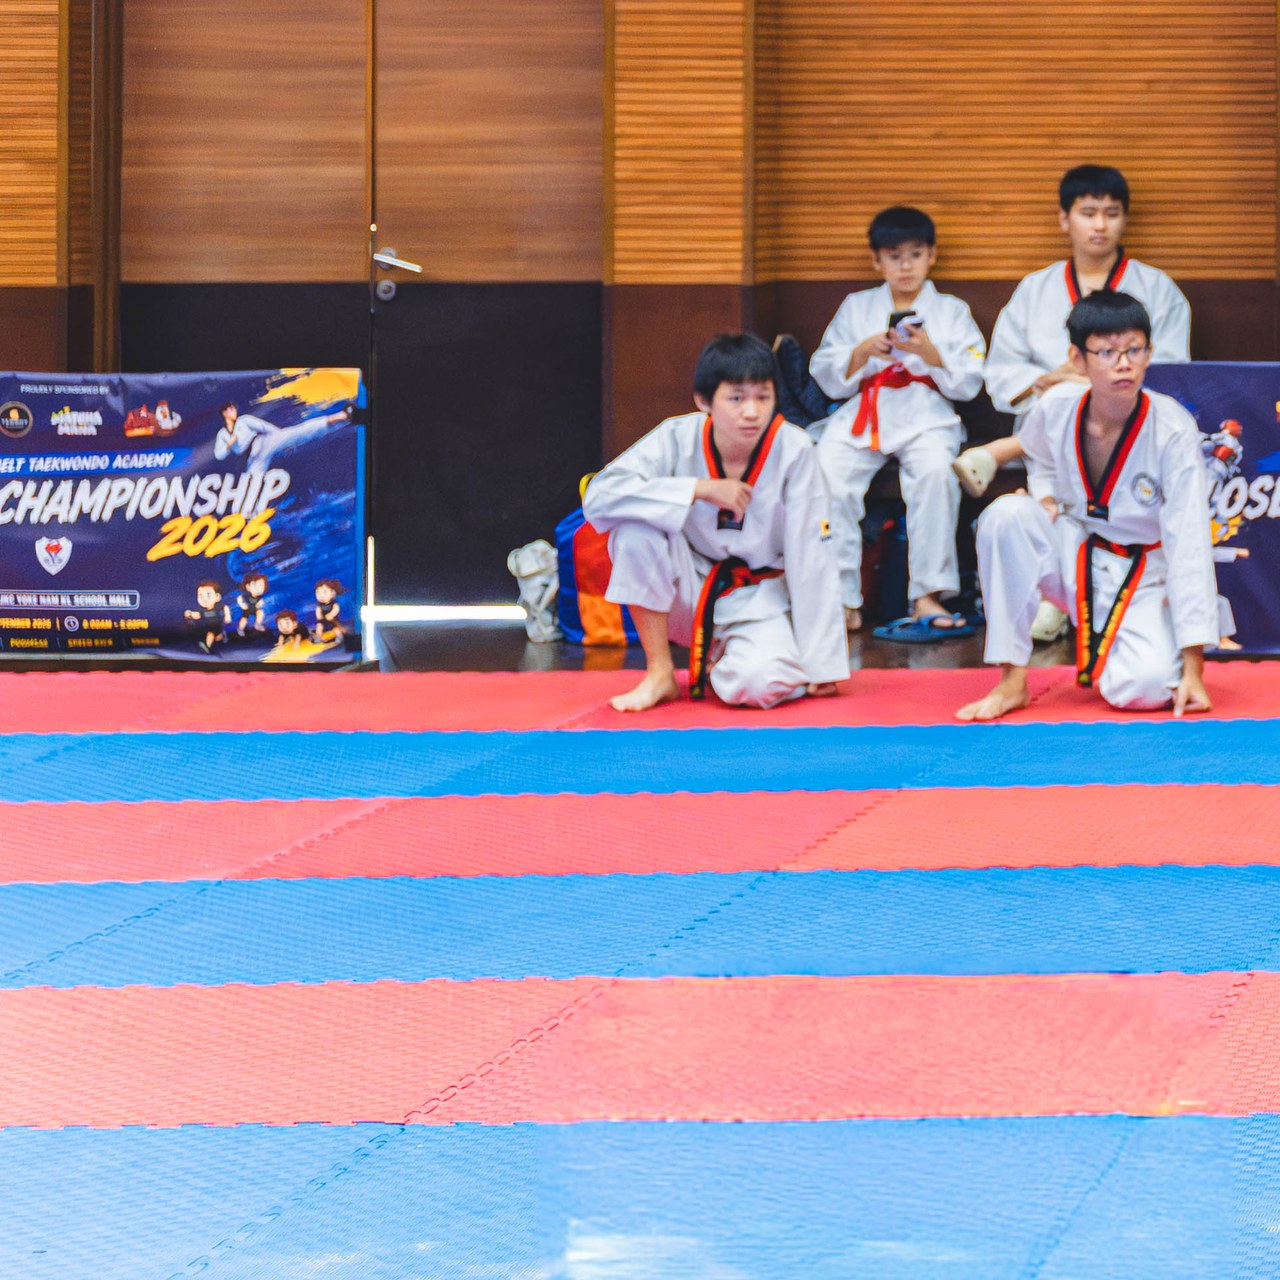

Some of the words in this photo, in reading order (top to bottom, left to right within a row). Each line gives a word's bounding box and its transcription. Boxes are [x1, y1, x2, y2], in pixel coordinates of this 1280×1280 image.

[0, 457, 26, 473] ELT
[29, 454, 110, 472] TAEKWONDO
[112, 452, 174, 470] ACADEMY
[0, 468, 291, 525] CHAMPIONSHIP
[146, 507, 277, 562] 2026
